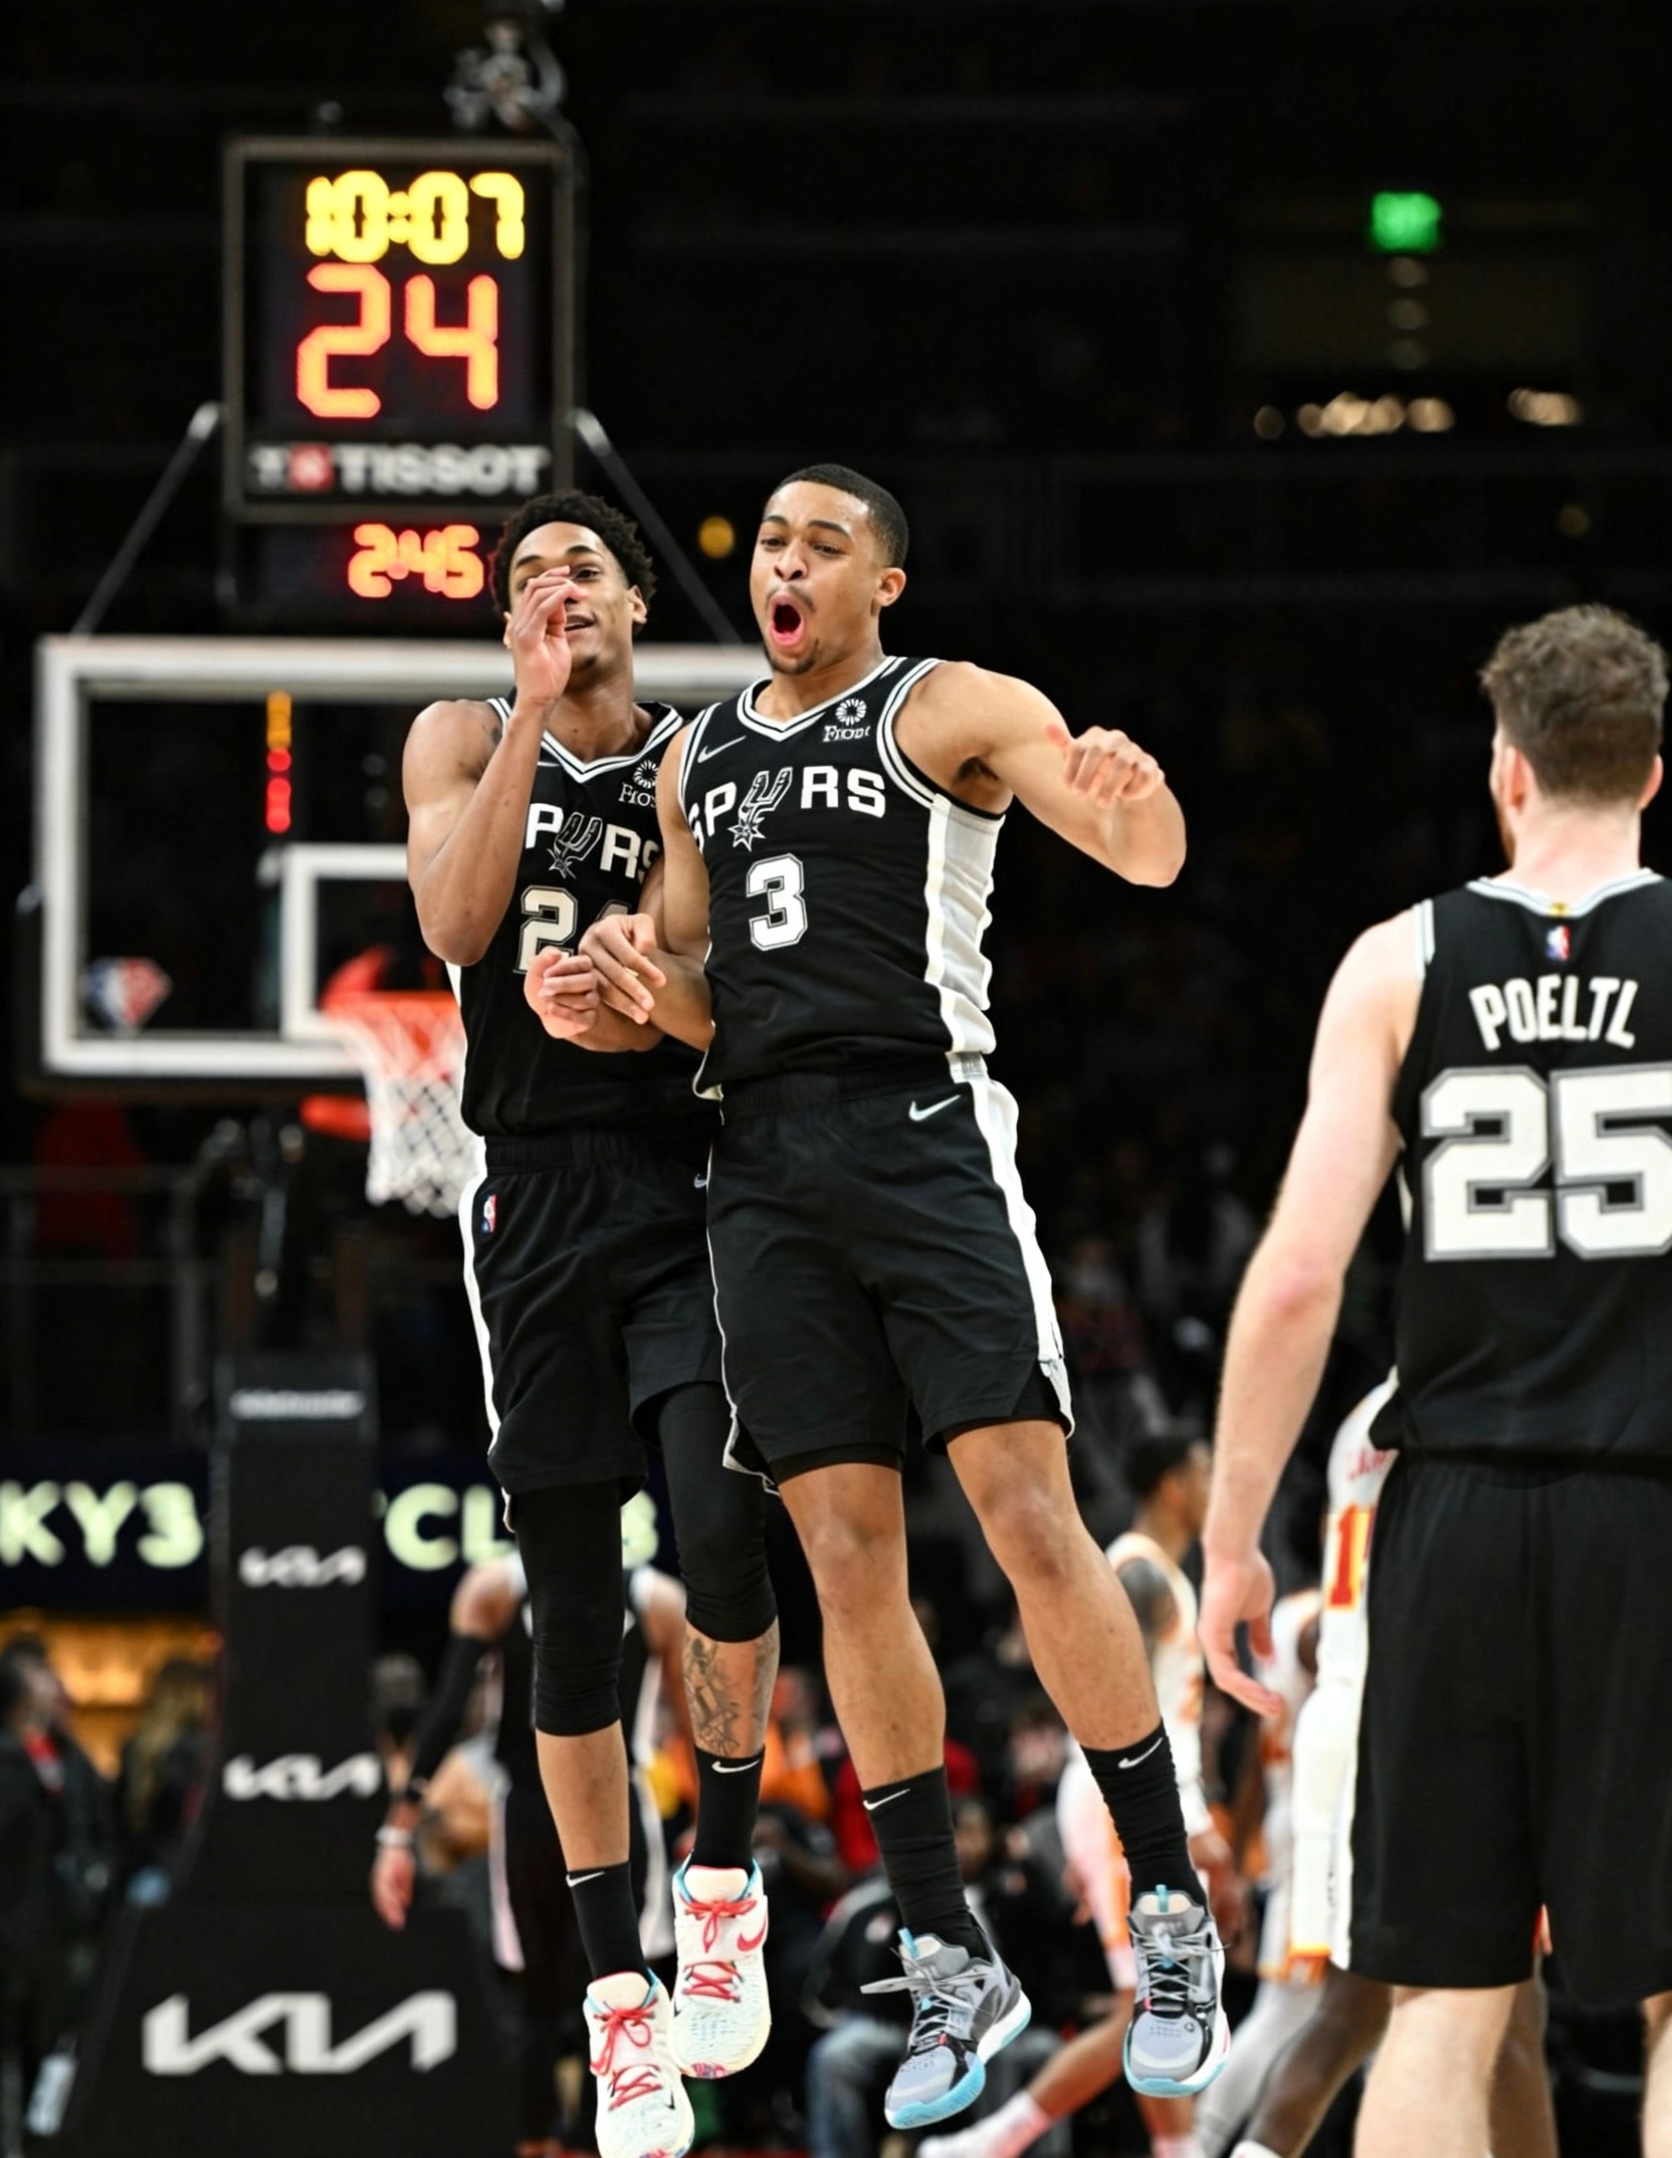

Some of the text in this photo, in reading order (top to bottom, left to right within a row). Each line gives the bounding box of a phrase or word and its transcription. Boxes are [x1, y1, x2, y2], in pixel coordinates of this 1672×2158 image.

[296, 262, 498, 418] 24
[336, 444, 549, 495] TISSOT
[512, 885, 633, 975] 2
[745, 852, 808, 951] 3
[1469, 974, 1638, 1051] POELTL
[1420, 1061, 1672, 1261] 25
[143, 1992, 457, 2074] KIA
